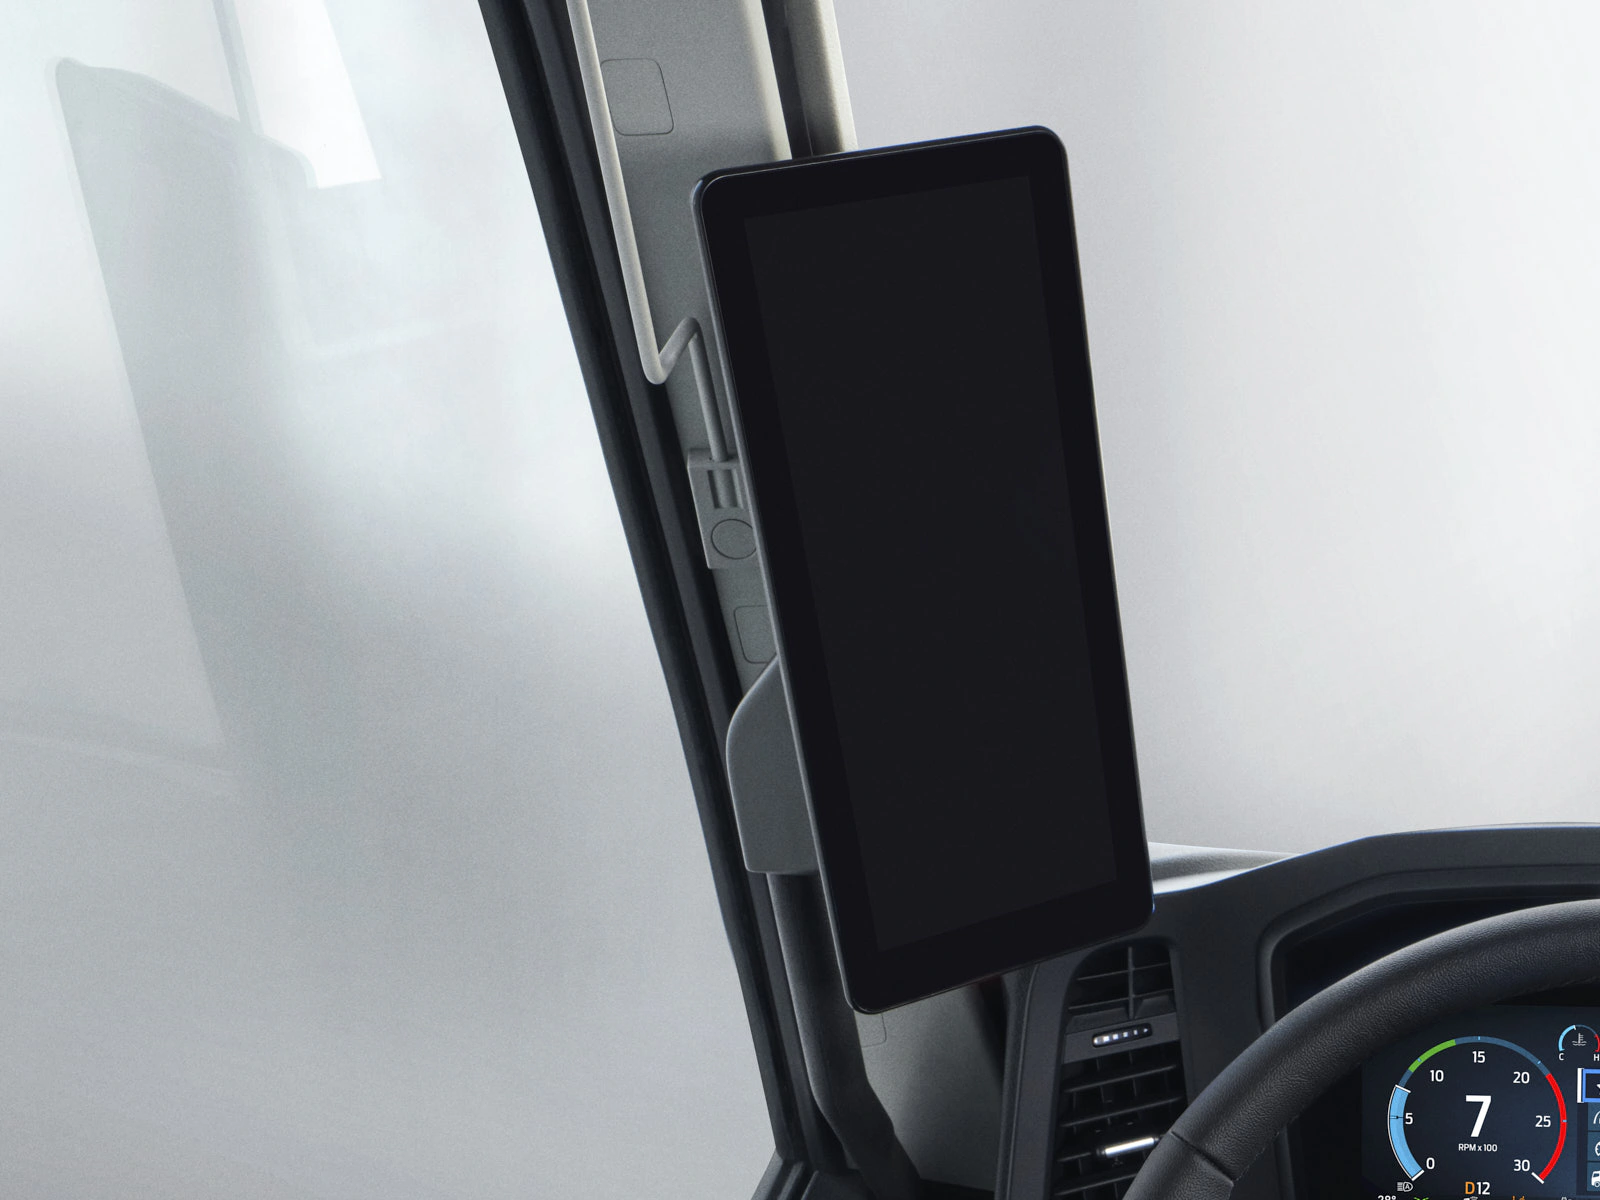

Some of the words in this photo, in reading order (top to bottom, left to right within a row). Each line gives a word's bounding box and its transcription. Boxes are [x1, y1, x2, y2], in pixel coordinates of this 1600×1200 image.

[1472, 1051, 1485, 1063] 15
[1558, 1053, 1565, 1061] C
[1594, 1054, 1600, 1062] H
[1430, 1070, 1444, 1082] 10
[1513, 1071, 1530, 1084] 20
[1405, 1113, 1414, 1125] 5
[1465, 1095, 1492, 1138] 7
[1535, 1115, 1551, 1127] 25
[1458, 1143, 1476, 1152] RPM
[1482, 1143, 1498, 1152] 100
[1425, 1157, 1436, 1170] 0
[1513, 1159, 1531, 1172] 30
